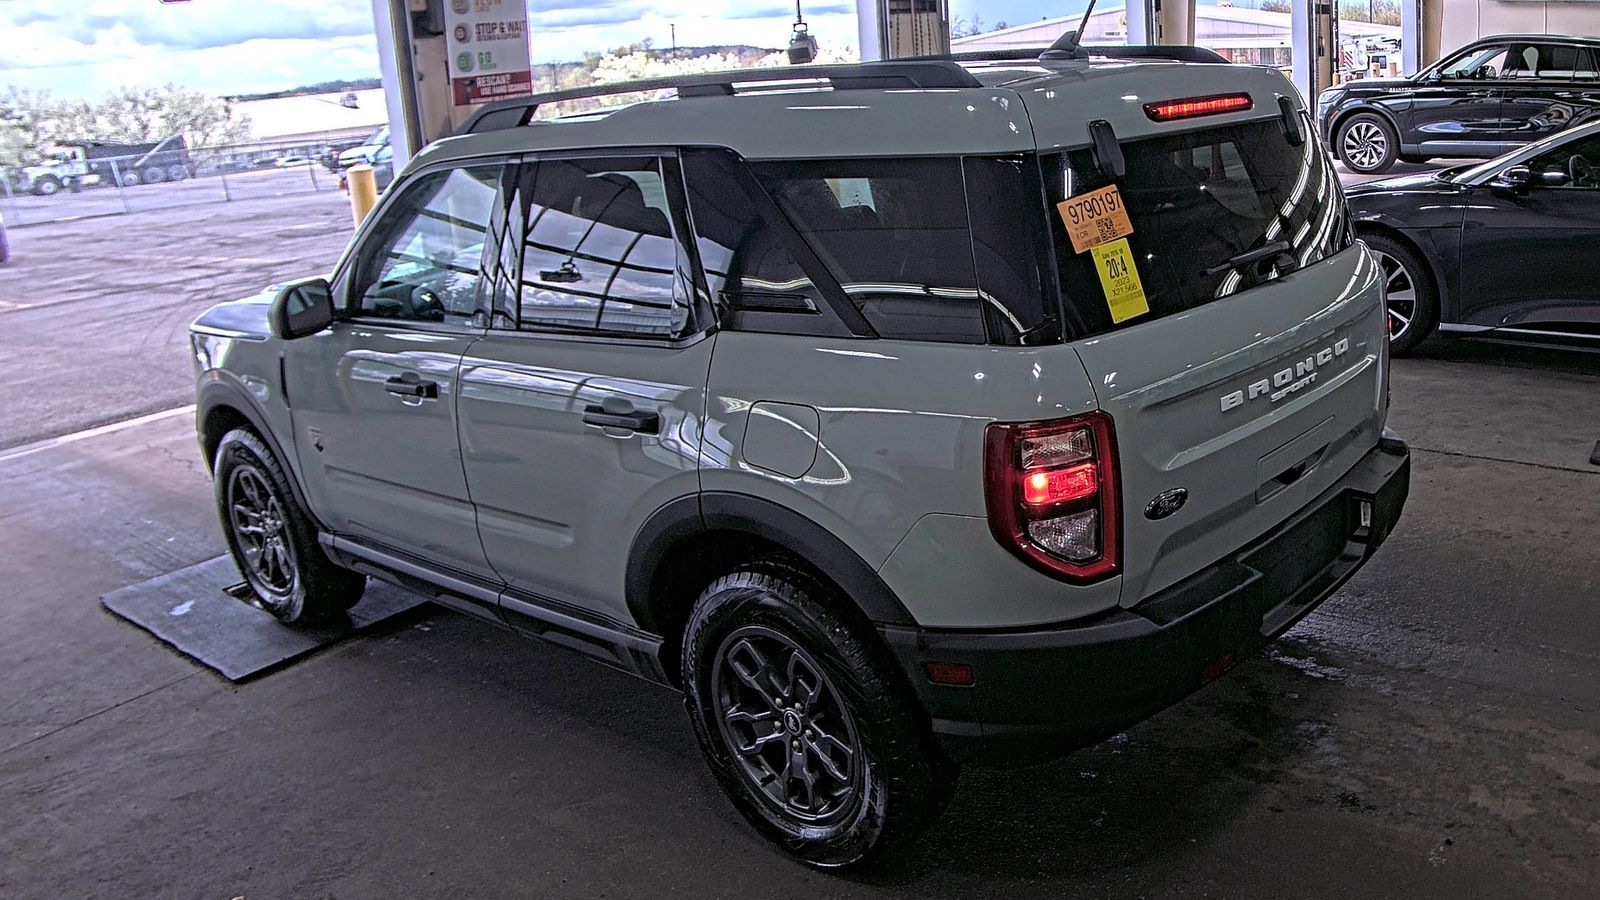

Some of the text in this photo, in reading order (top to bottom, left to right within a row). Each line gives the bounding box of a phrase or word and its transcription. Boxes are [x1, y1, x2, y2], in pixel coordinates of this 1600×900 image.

[475, 22, 498, 34] STOP
[507, 20, 527, 32] WAIT
[478, 51, 492, 64] GO
[1068, 190, 1121, 225] 9790197
[1106, 255, 1128, 280] 20:4
[1220, 337, 1349, 412] BRONCO
[1271, 372, 1318, 402] SPORT
